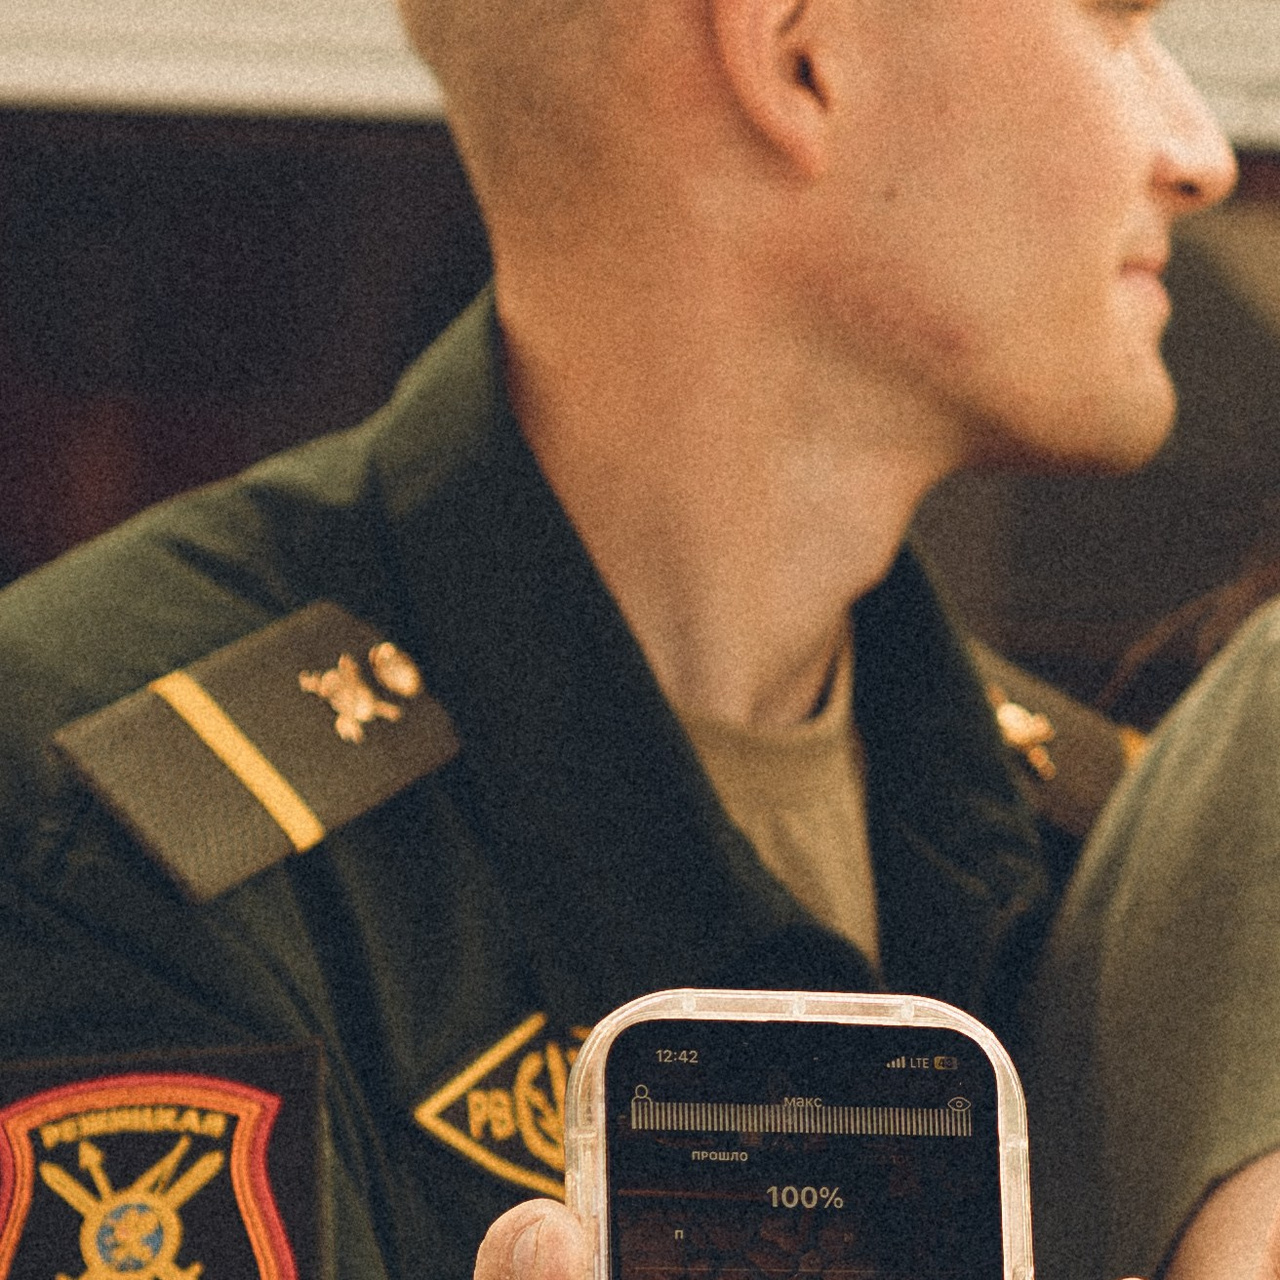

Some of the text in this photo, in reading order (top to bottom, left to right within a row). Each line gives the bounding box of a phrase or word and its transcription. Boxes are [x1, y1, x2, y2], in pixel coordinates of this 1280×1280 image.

[656, 1050, 698, 1063] 12:42
[910, 1057, 930, 1069] LTE
[784, 1096, 823, 1108] макс
[692, 1149, 748, 1163] прошло
[766, 1186, 844, 1209] 100%
